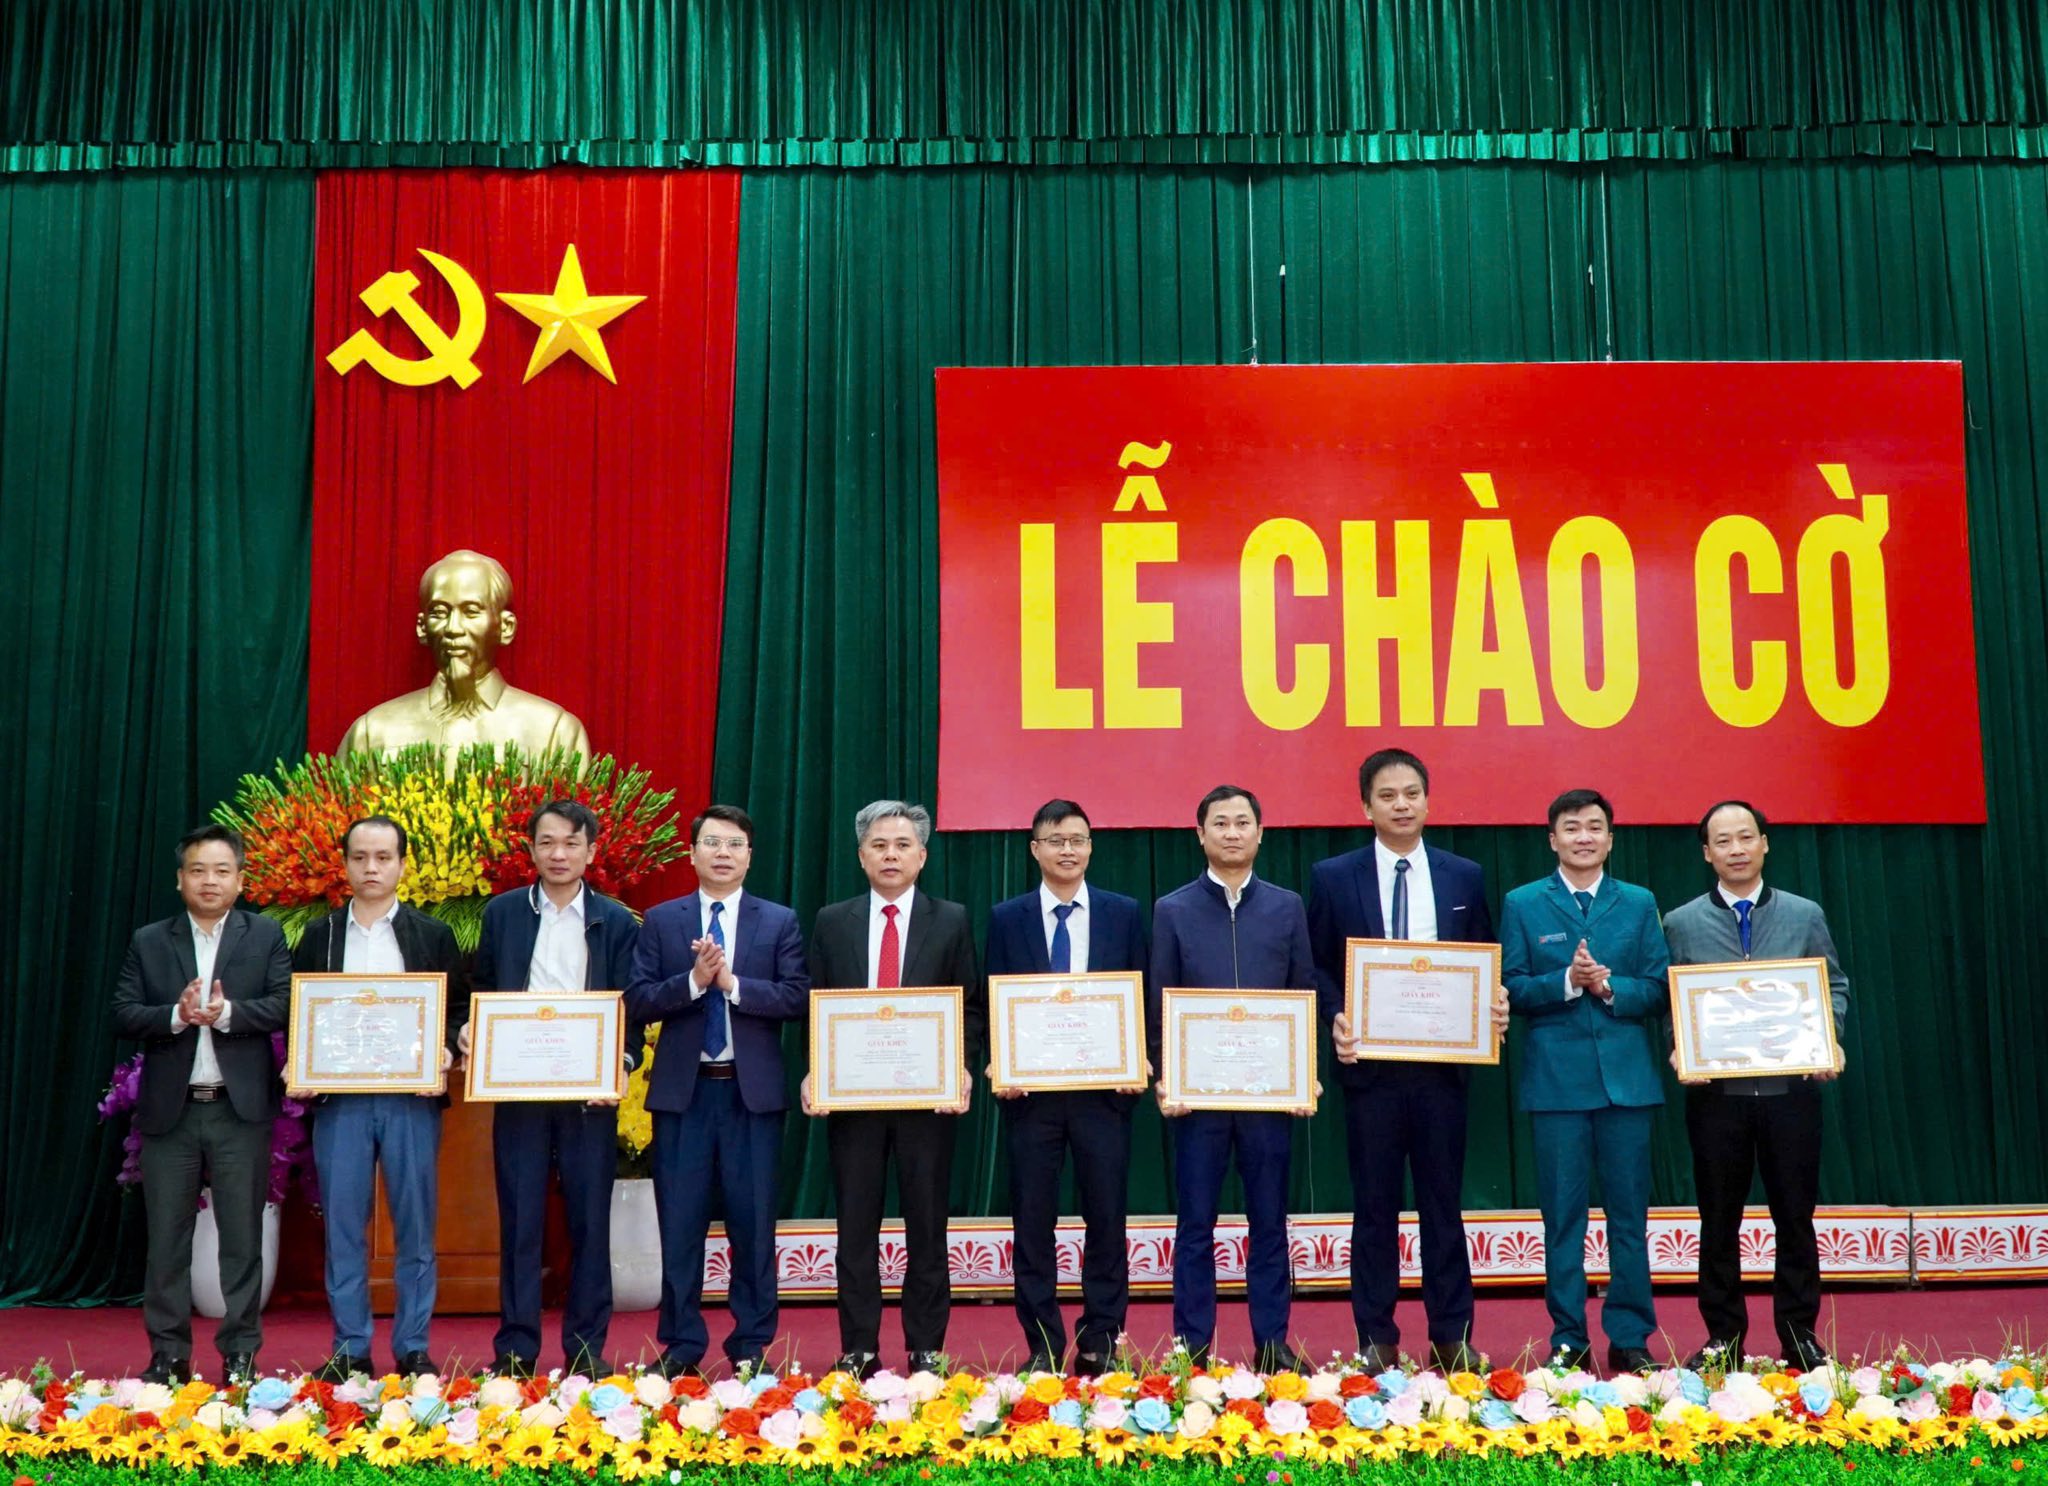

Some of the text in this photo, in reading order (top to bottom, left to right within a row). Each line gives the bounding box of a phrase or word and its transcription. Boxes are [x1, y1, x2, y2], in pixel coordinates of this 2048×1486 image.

[1020, 440, 1890, 731] LỄ CHÀO CỜ
